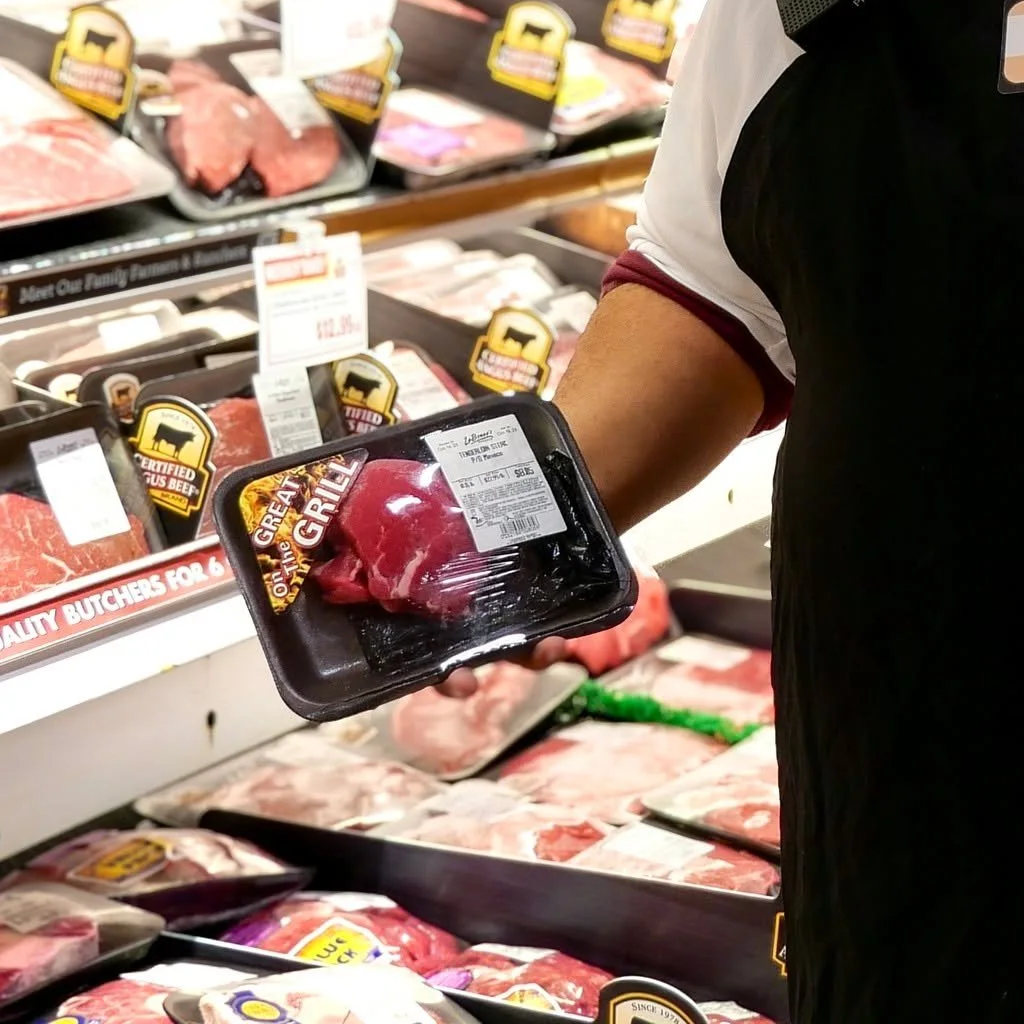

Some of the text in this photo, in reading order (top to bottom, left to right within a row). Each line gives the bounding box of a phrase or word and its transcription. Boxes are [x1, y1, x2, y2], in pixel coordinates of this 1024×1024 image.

[253, 476, 300, 546] GREAT
[293, 461, 359, 547] GRILL
[62, 576, 168, 627] BUTCHERS
[164, 561, 209, 592] FOR
[272, 540, 301, 598] On The
[631, 1002, 657, 1017] SINCE
